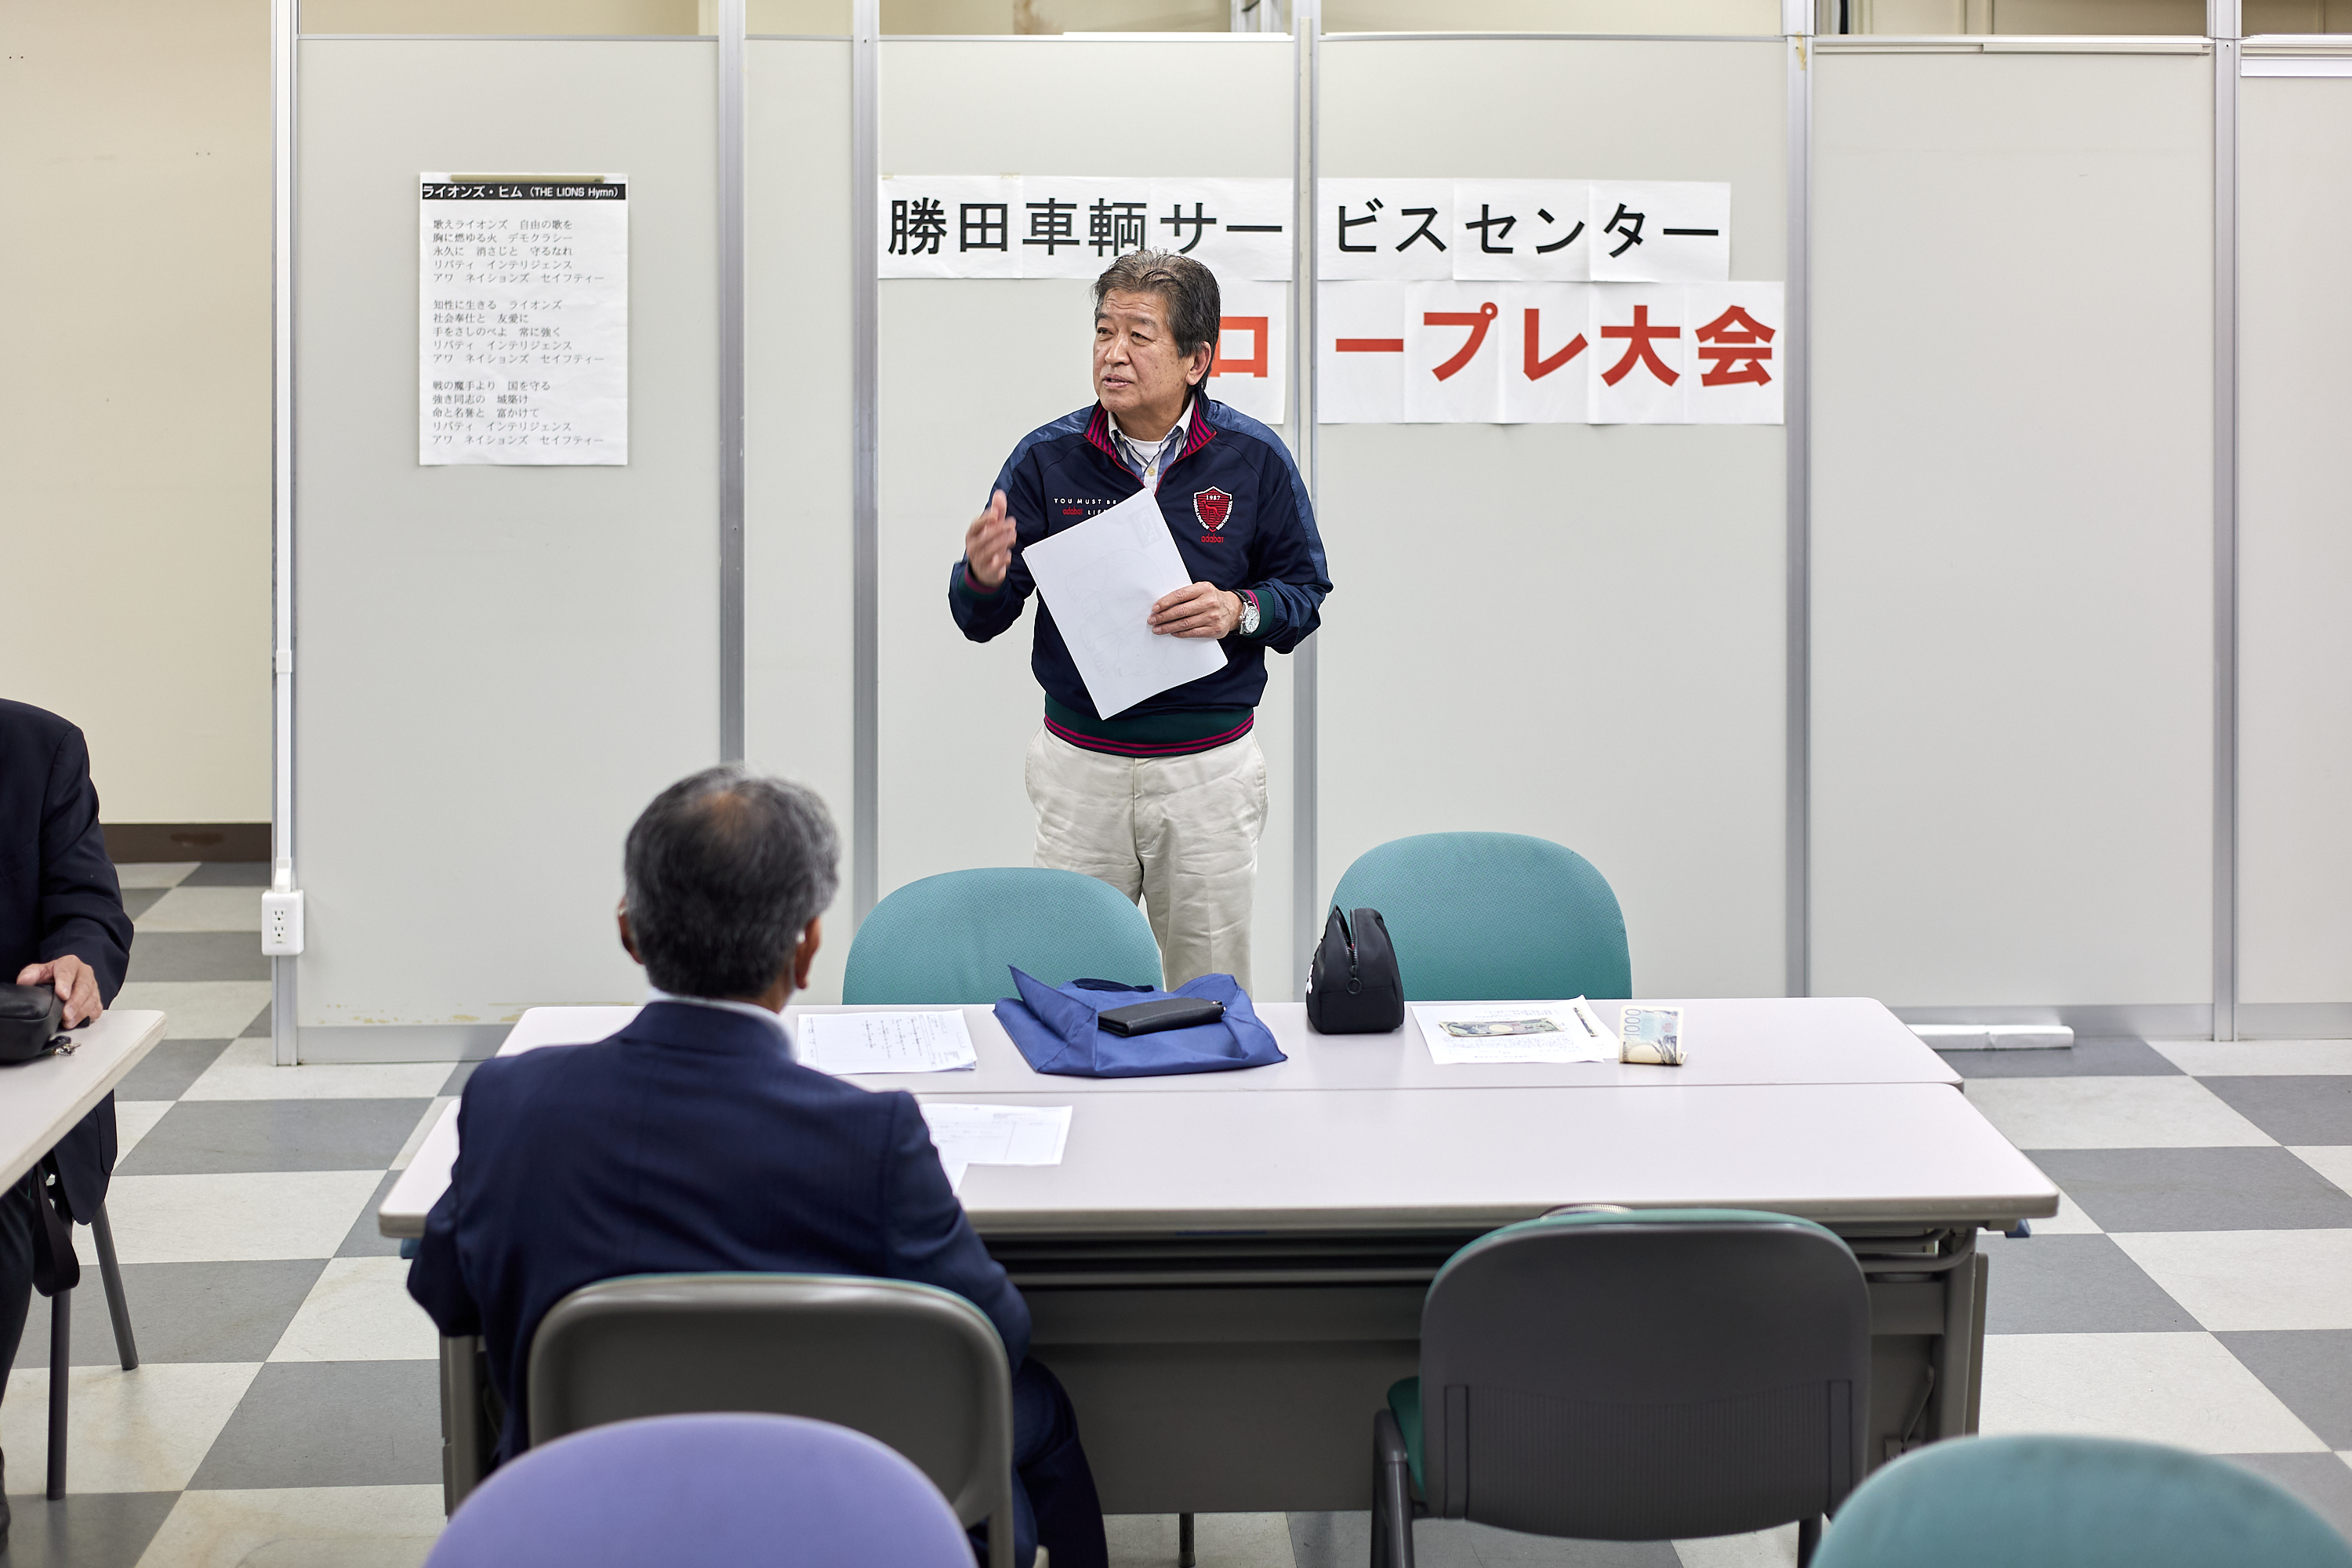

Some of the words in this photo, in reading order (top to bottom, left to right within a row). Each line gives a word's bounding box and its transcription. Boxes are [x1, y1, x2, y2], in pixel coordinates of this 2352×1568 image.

[423, 185, 523, 198] ライオンズ・ヒム
[529, 186, 554, 198] （THE
[556, 186, 585, 198] LIONS
[588, 187, 619, 199] Hymn）
[434, 219, 509, 230] 歌えライオンズ
[520, 219, 572, 230] 自由の歌を
[433, 232, 497, 244] 胸に燃ゆる火
[508, 232, 573, 244] デモクラシー
[433, 245, 464, 257] 永久に
[476, 245, 518, 257] 消さじと
[529, 245, 573, 257] 守るなれ
[434, 260, 474, 270] リバティ
[487, 260, 572, 270] インテリジェンス
[434, 272, 454, 284] アワ
[465, 272, 530, 284] ネイションズ
[541, 272, 604, 284] セイフティー
[434, 299, 497, 310] 知性に生きる
[510, 299, 562, 310] ライオンズ
[433, 312, 485, 325] 社会奉仕と
[497, 312, 529, 325] 友愛に
[433, 326, 507, 338] 手をさしのべよ
[519, 326, 561, 338] 常に強く
[434, 339, 474, 350] リバティ
[487, 339, 572, 350] インテリジェンス
[433, 354, 453, 365] アワ
[466, 354, 529, 365] ネイションズ
[540, 354, 604, 365] セイフティー
[432, 380, 496, 392] 戦の魔手より
[507, 380, 551, 392] 国を守る
[432, 394, 486, 405] 強き同志の
[432, 407, 485, 419] 命と名誉と
[496, 407, 540, 419] 富かけて
[434, 421, 473, 432] リバティ
[487, 421, 572, 432] インテリジェンス
[433, 434, 453, 445] アワ
[465, 434, 528, 445] ネイションズ
[539, 434, 604, 445] セイフティー
[1623, 1008, 1641, 1036] 1000
